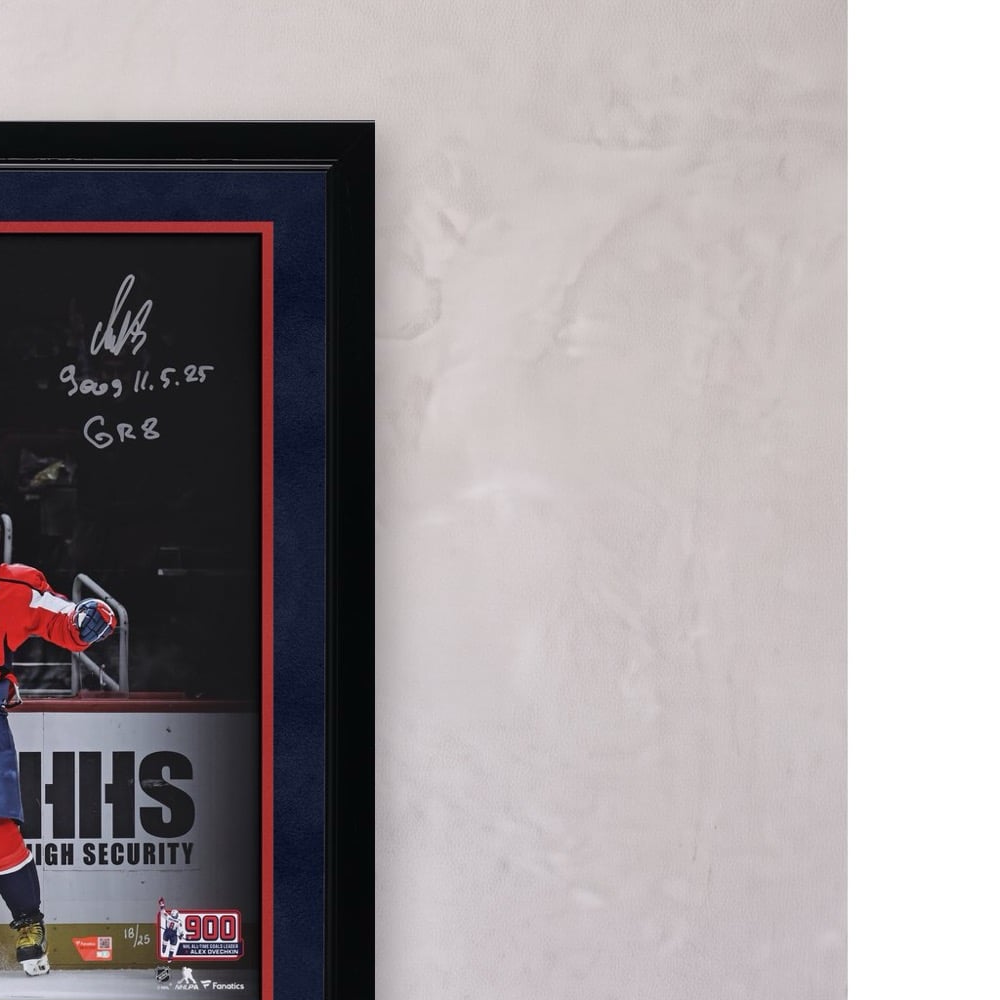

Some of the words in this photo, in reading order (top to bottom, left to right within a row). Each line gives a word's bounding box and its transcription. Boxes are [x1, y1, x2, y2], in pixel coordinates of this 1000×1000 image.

[134, 364, 214, 393] 11.5.25
[84, 415, 160, 449] GR8
[19, 751, 195, 839] HHS
[26, 843, 73, 866] IGH
[83, 843, 194, 866] SECURITY
[124, 924, 150, 948] 18/25
[185, 915, 236, 942] 900
[212, 982, 245, 990] Fanatics
